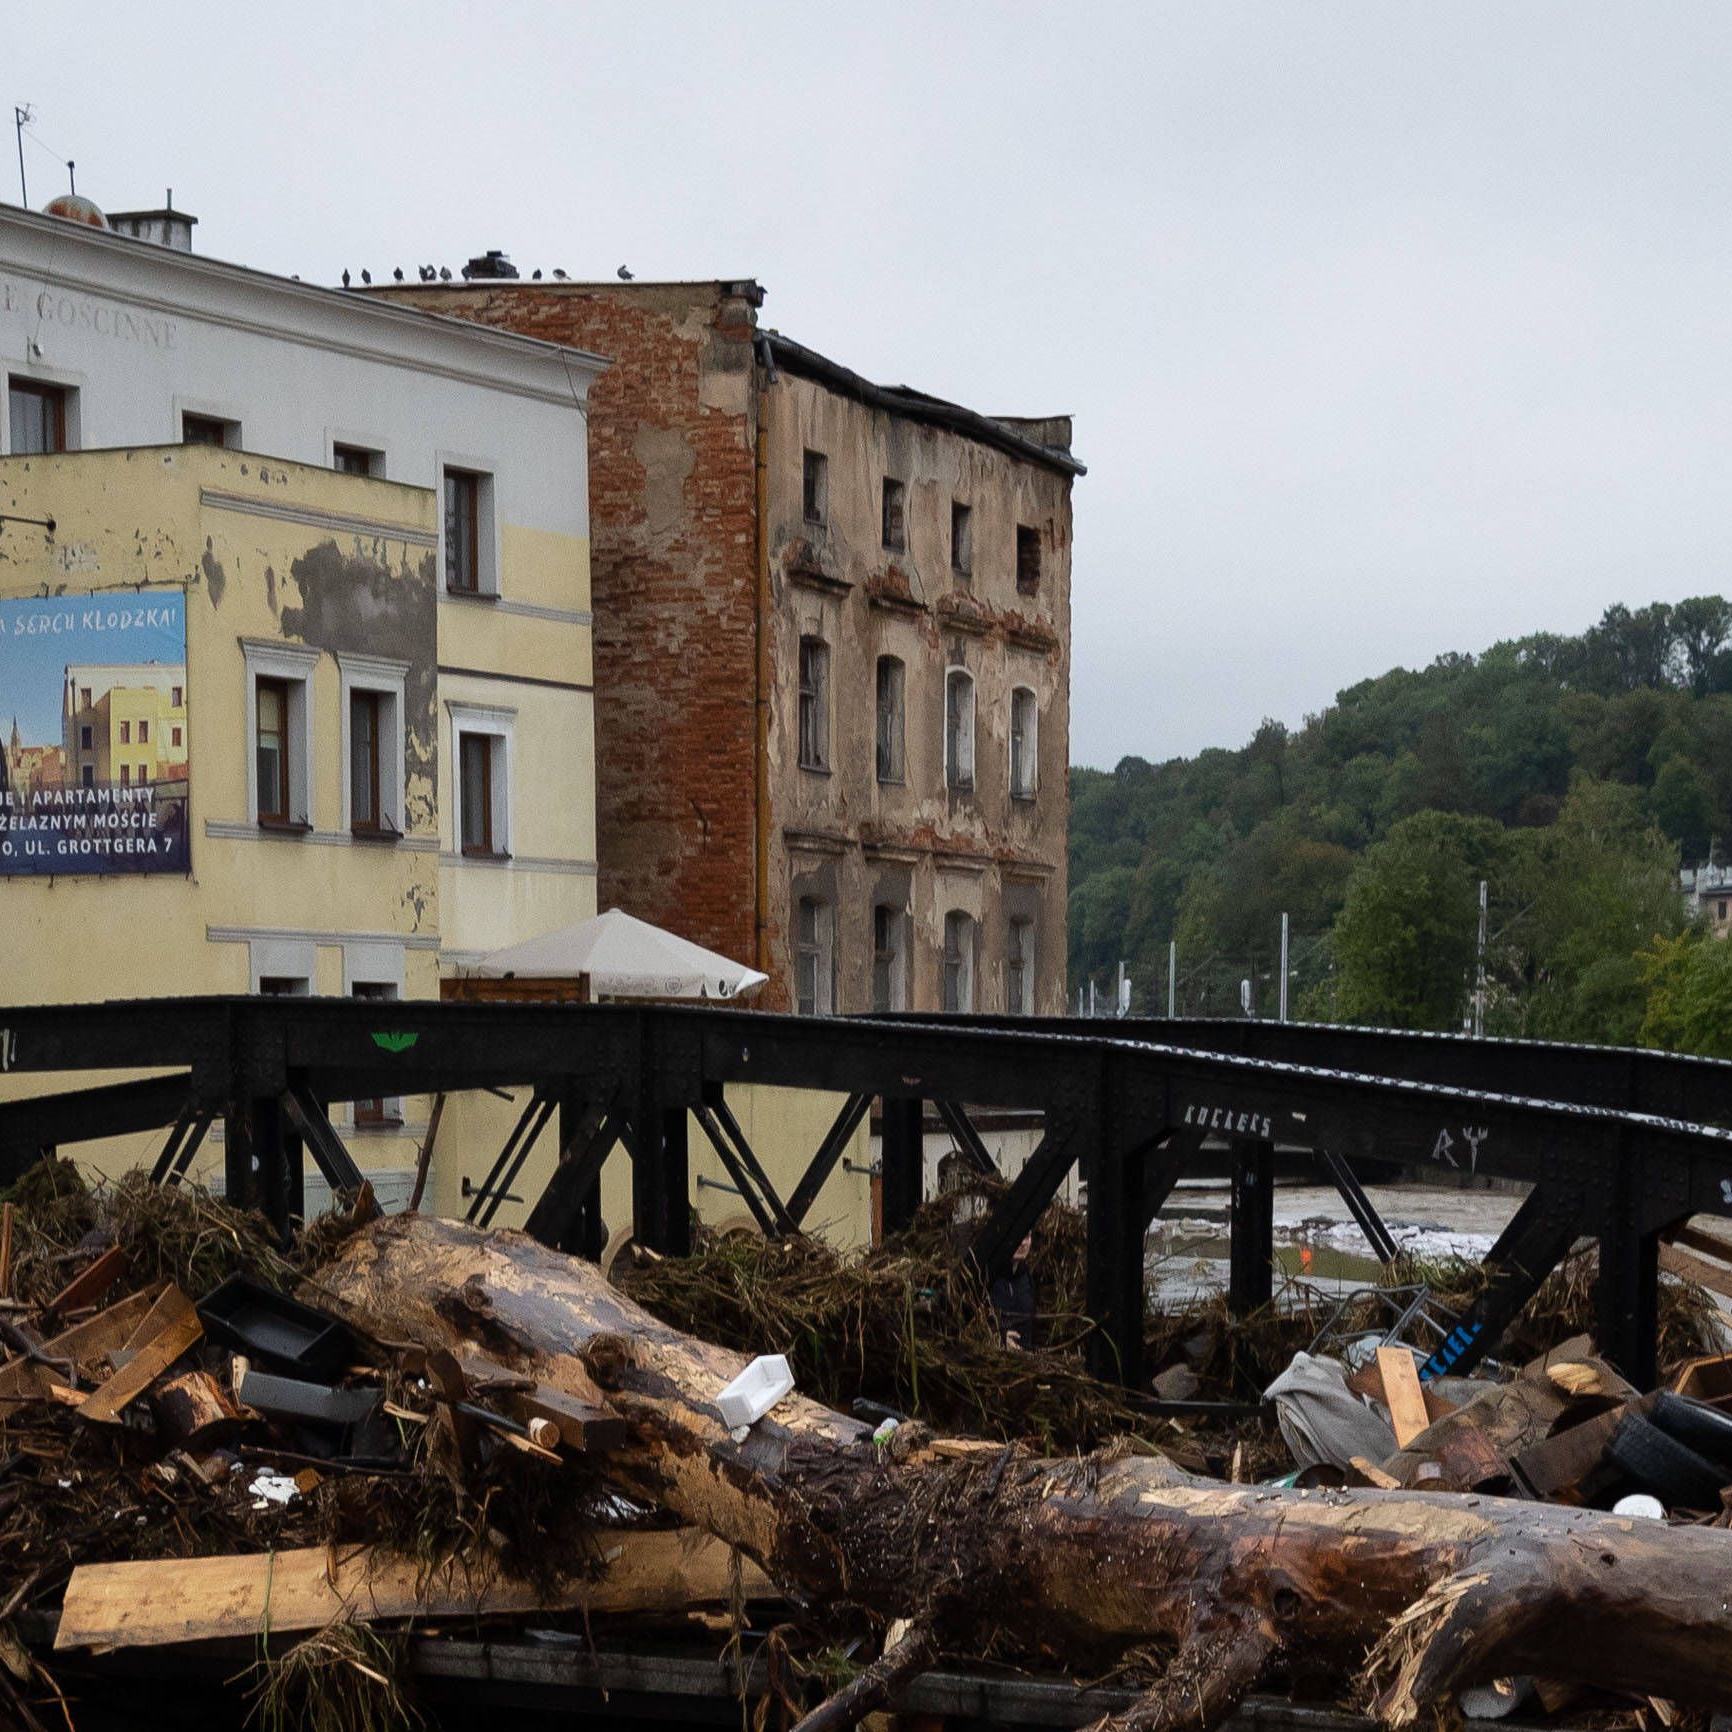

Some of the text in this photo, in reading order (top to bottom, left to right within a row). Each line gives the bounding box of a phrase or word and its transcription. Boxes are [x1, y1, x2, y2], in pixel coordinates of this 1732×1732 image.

[14, 613, 75, 636] SERCU
[33, 787, 156, 805] APARTAMENTY
[94, 811, 157, 829] MOŚCIE
[25, 840, 51, 856] UL.
[57, 837, 157, 854] GROTTGERA
[164, 837, 173, 853] 7
